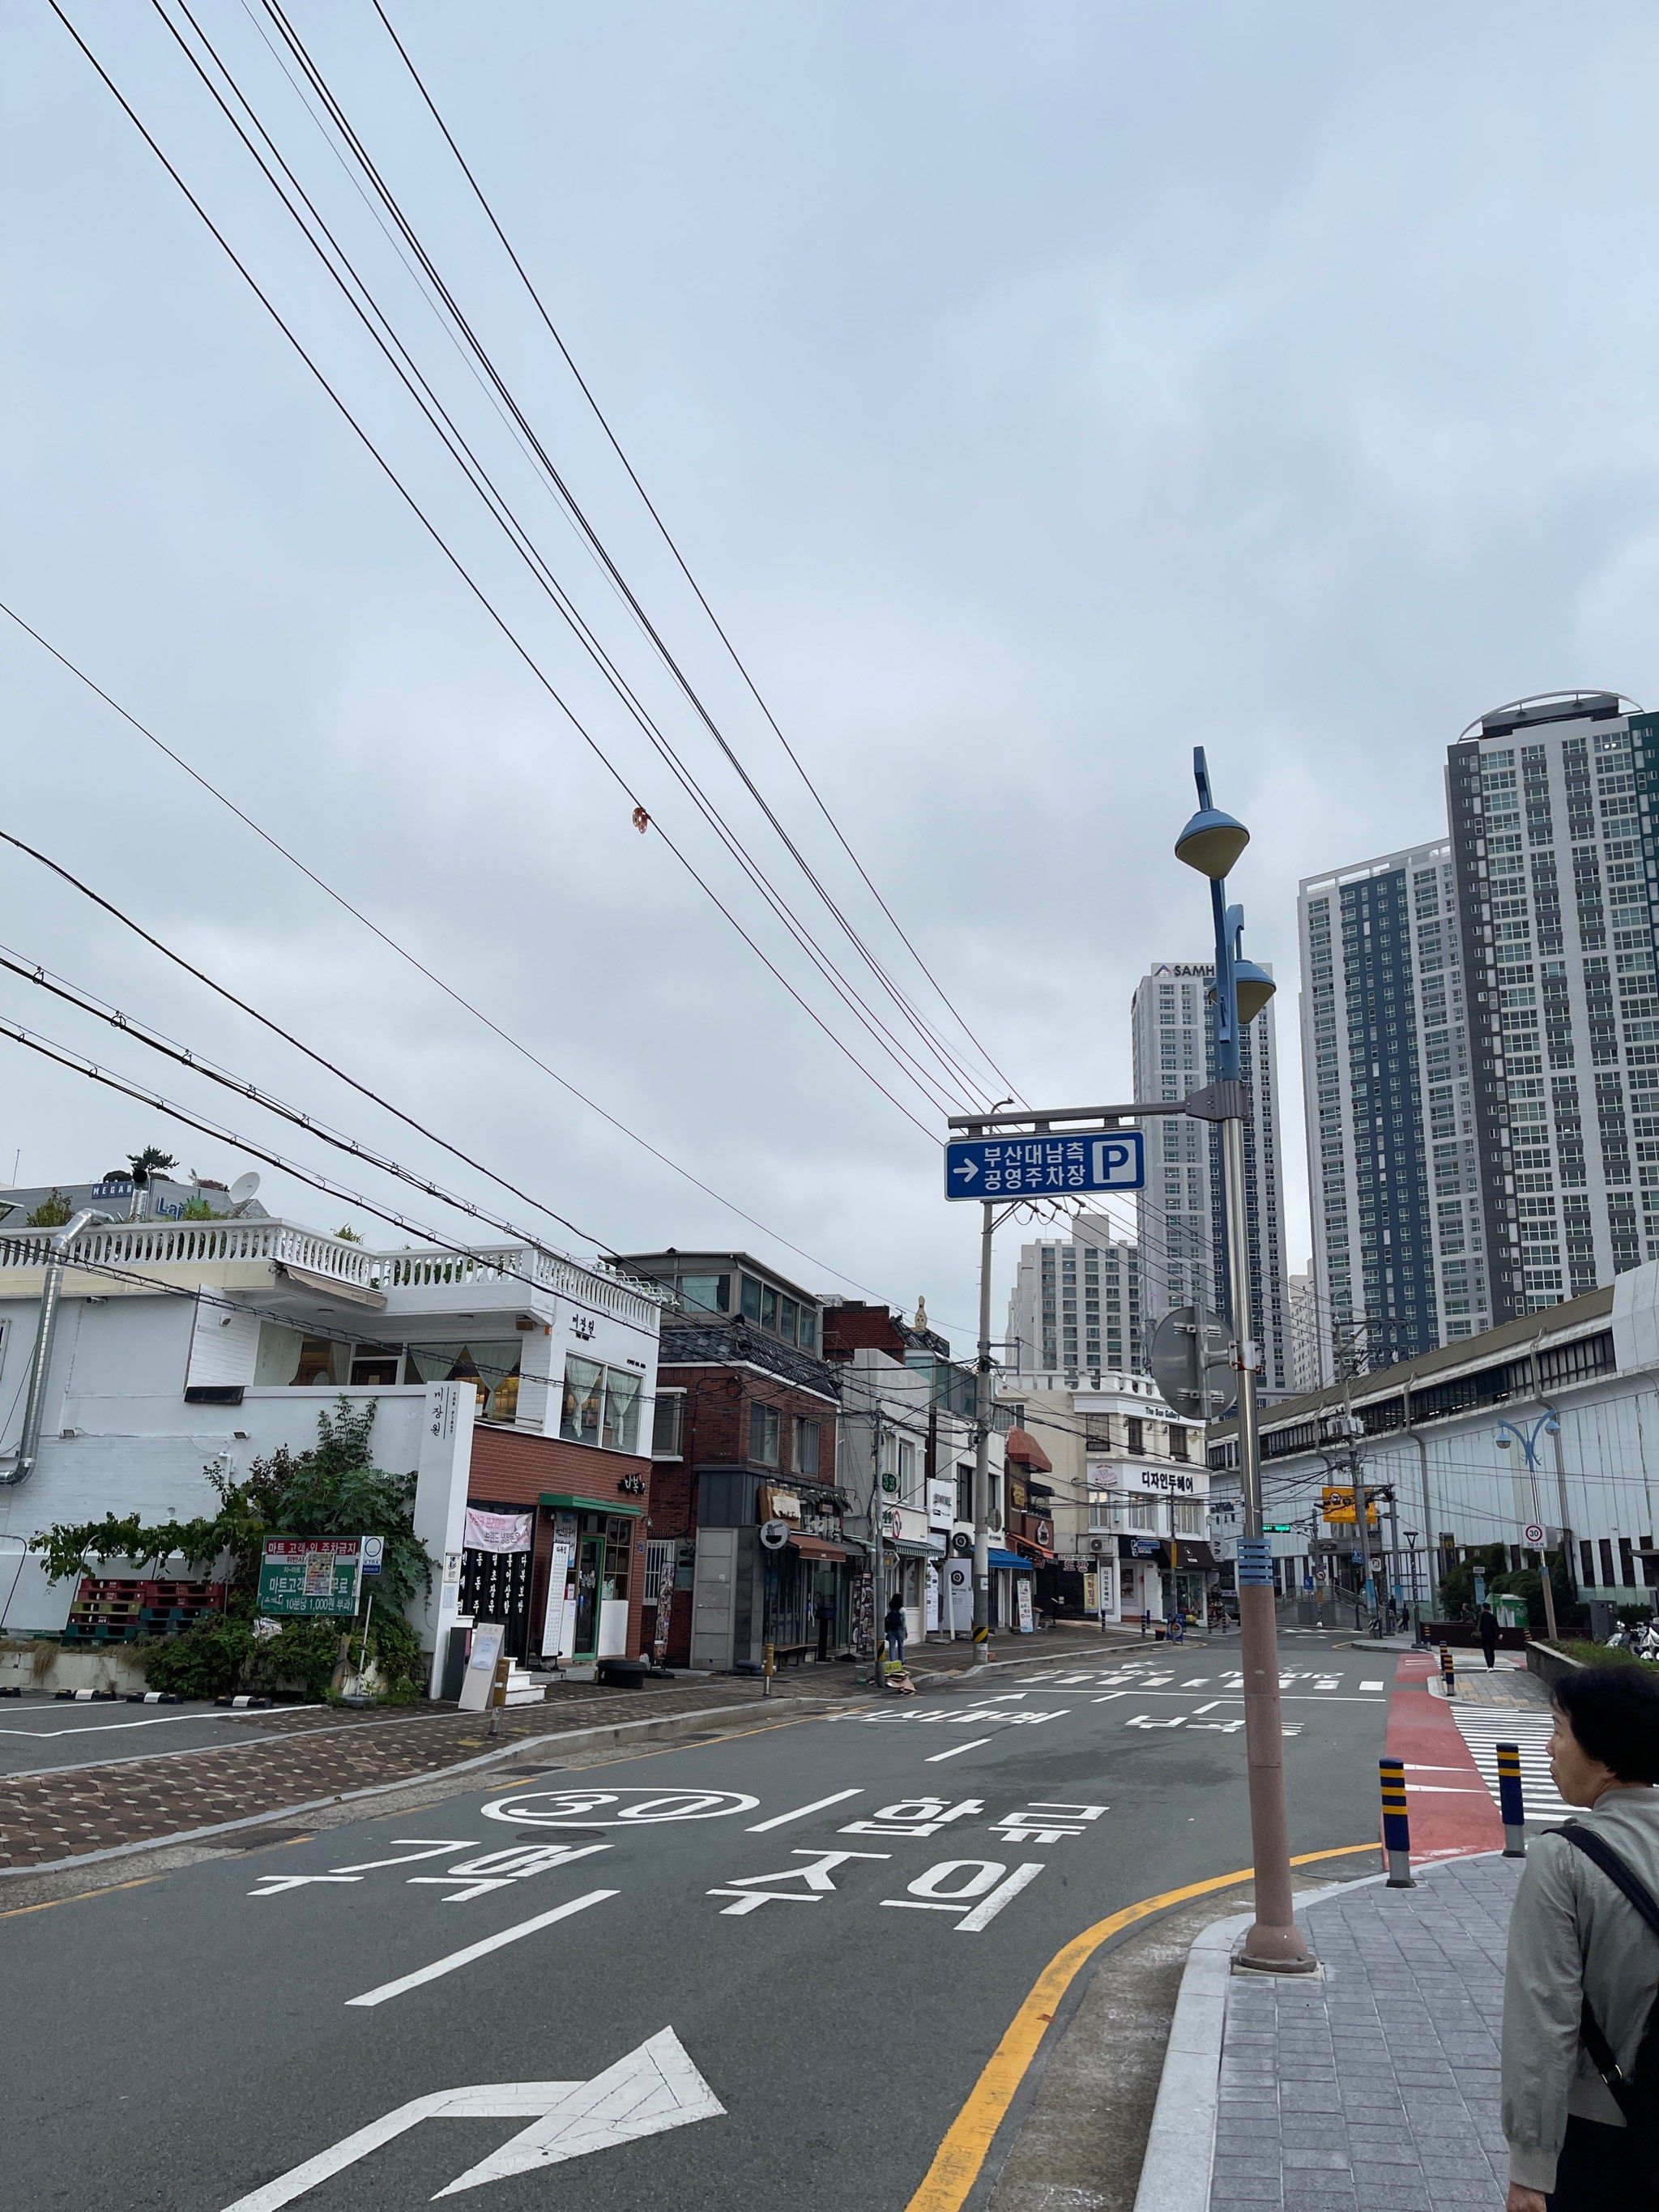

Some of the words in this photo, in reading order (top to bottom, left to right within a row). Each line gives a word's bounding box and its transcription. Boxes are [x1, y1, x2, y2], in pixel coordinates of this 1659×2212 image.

[983, 1142, 1085, 1168] 부산대남측
[1102, 1144, 1129, 1181] P
[983, 1164, 1086, 1191] 공영주차장
[572, 1313, 595, 1335] 미장원
[430, 1387, 444, 1437] 미장원
[1145, 1407, 1154, 1416] The
[1141, 1471, 1194, 1493] 디자인두헤어
[268, 1542, 285, 1554] 마트
[288, 1543, 305, 1555] 고객
[321, 1542, 356, 1554] 주차금지
[472, 1552, 483, 1614] 동동주
[503, 1553, 513, 1614] 홍어삼합
[286, 1597, 308, 1611] 10분당
[309, 1597, 335, 1611] 1,000원
[507, 1793, 725, 1819] 30
[835, 1796, 1111, 1844] 합류
[246, 1838, 616, 1902] 구역
[705, 1848, 1047, 1933] 주의
